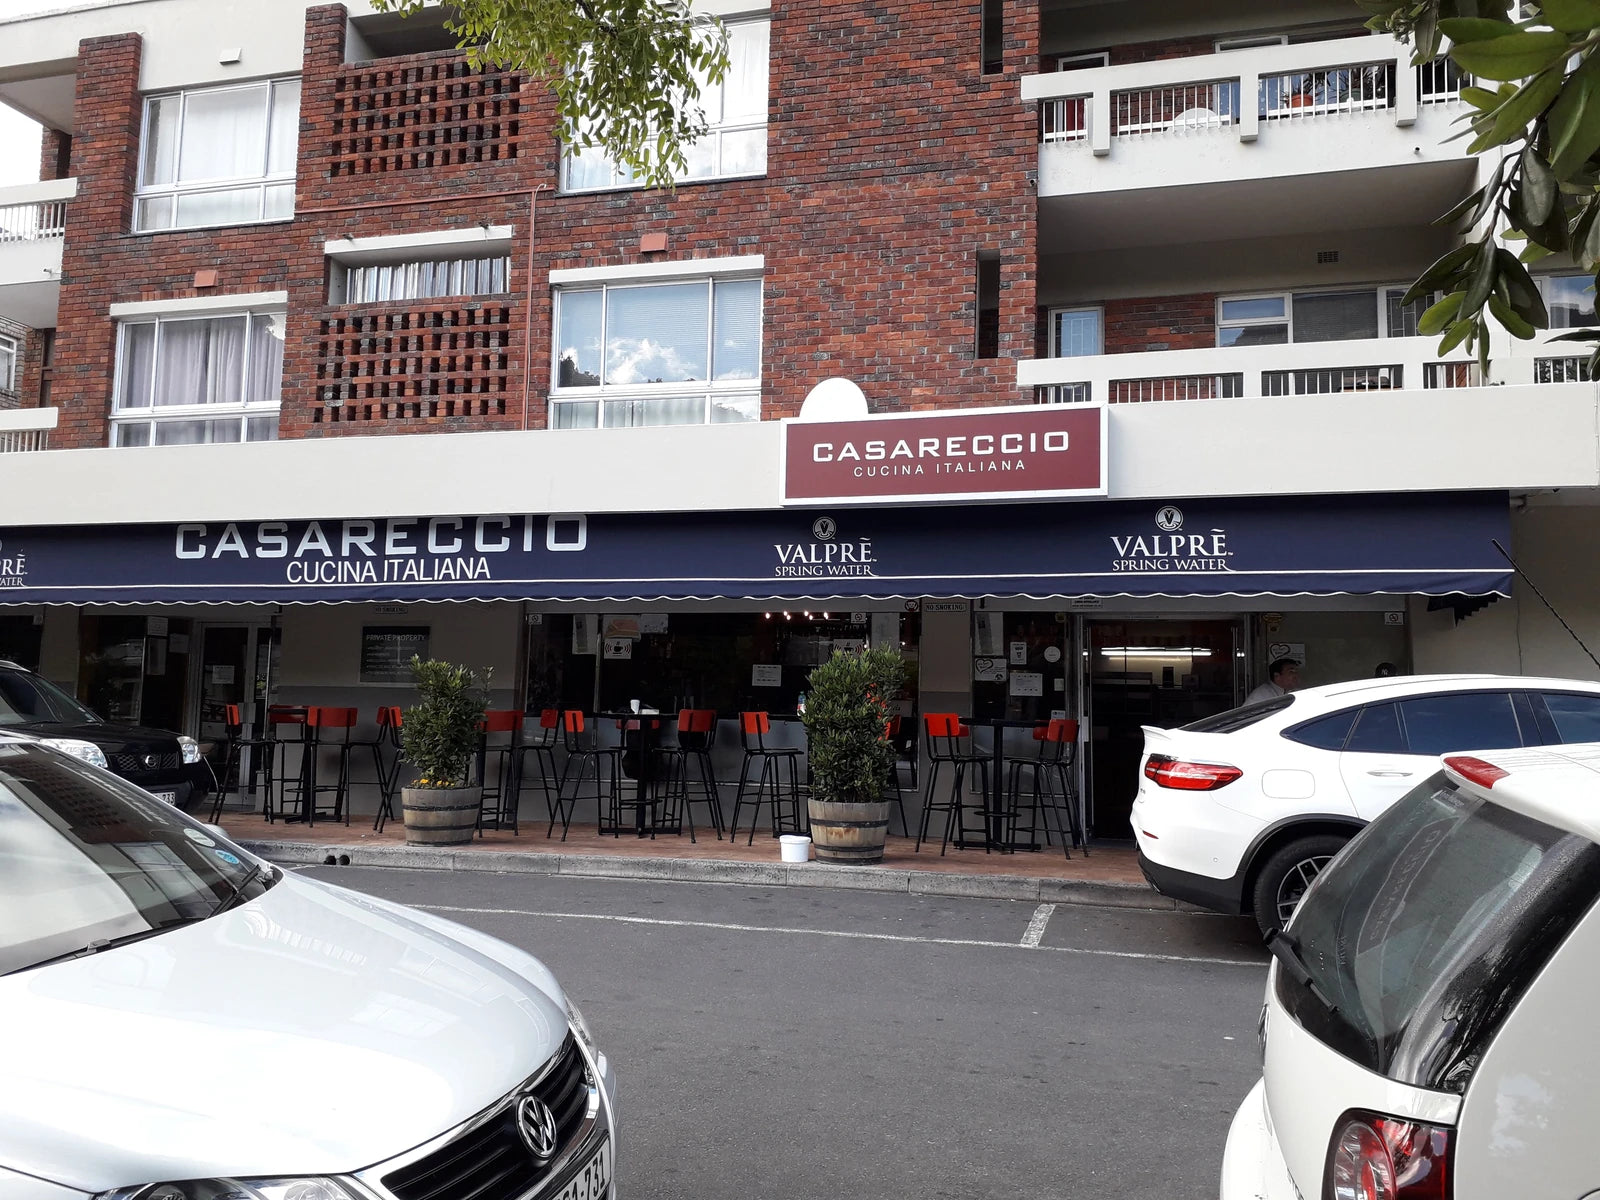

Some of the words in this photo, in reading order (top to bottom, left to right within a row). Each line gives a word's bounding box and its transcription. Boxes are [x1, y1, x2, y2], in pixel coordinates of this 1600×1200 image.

[813, 431, 1069, 463] CASARECCIO
[853, 464, 924, 477] CUCINA
[936, 459, 1025, 474] ITALIANA
[176, 514, 587, 559] CASARECCIO
[286, 561, 378, 583] CUCINA
[384, 557, 491, 581] ITALIANA
[775, 565, 823, 577] SPRING
[827, 565, 877, 577] WATER
[1112, 559, 1169, 572] SPRING
[1174, 559, 1234, 572] WATER
[0, 577, 24, 587] ATER
[366, 634, 391, 642] PRIVATE
[393, 634, 425, 642] PROPERTY
